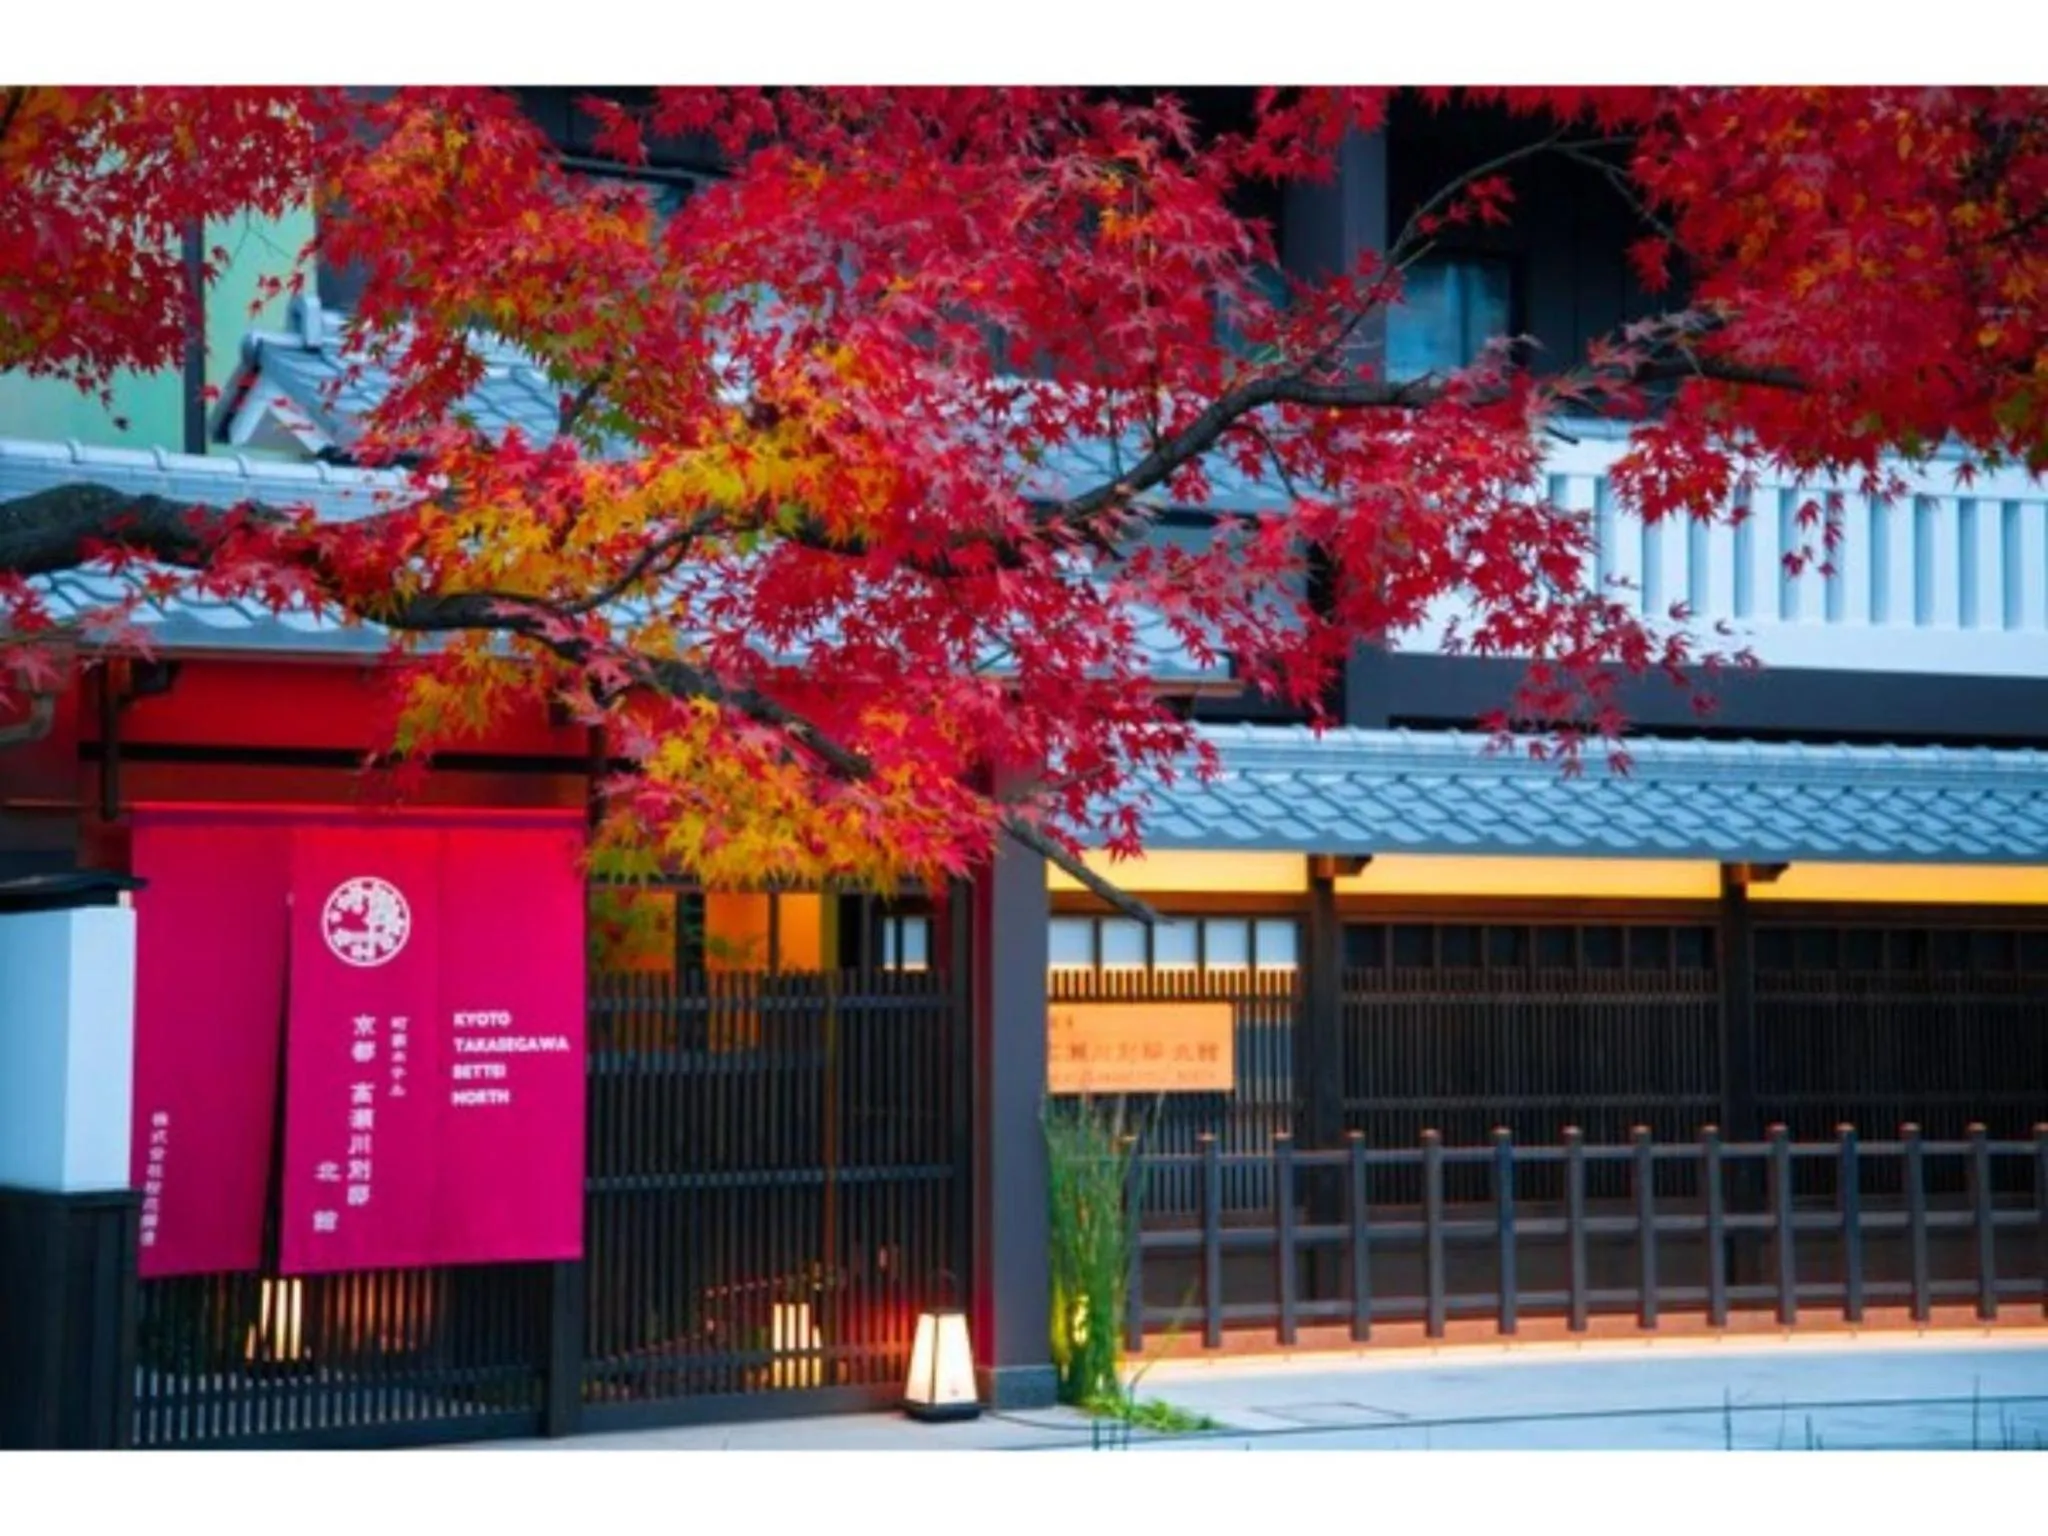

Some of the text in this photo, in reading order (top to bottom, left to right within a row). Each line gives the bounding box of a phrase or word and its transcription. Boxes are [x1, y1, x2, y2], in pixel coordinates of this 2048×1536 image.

[453, 1010, 511, 1028] KYOTO
[351, 1013, 377, 1063] 京都
[453, 1034, 570, 1053] TAKASEGAWA
[451, 1087, 511, 1106] NORTH
